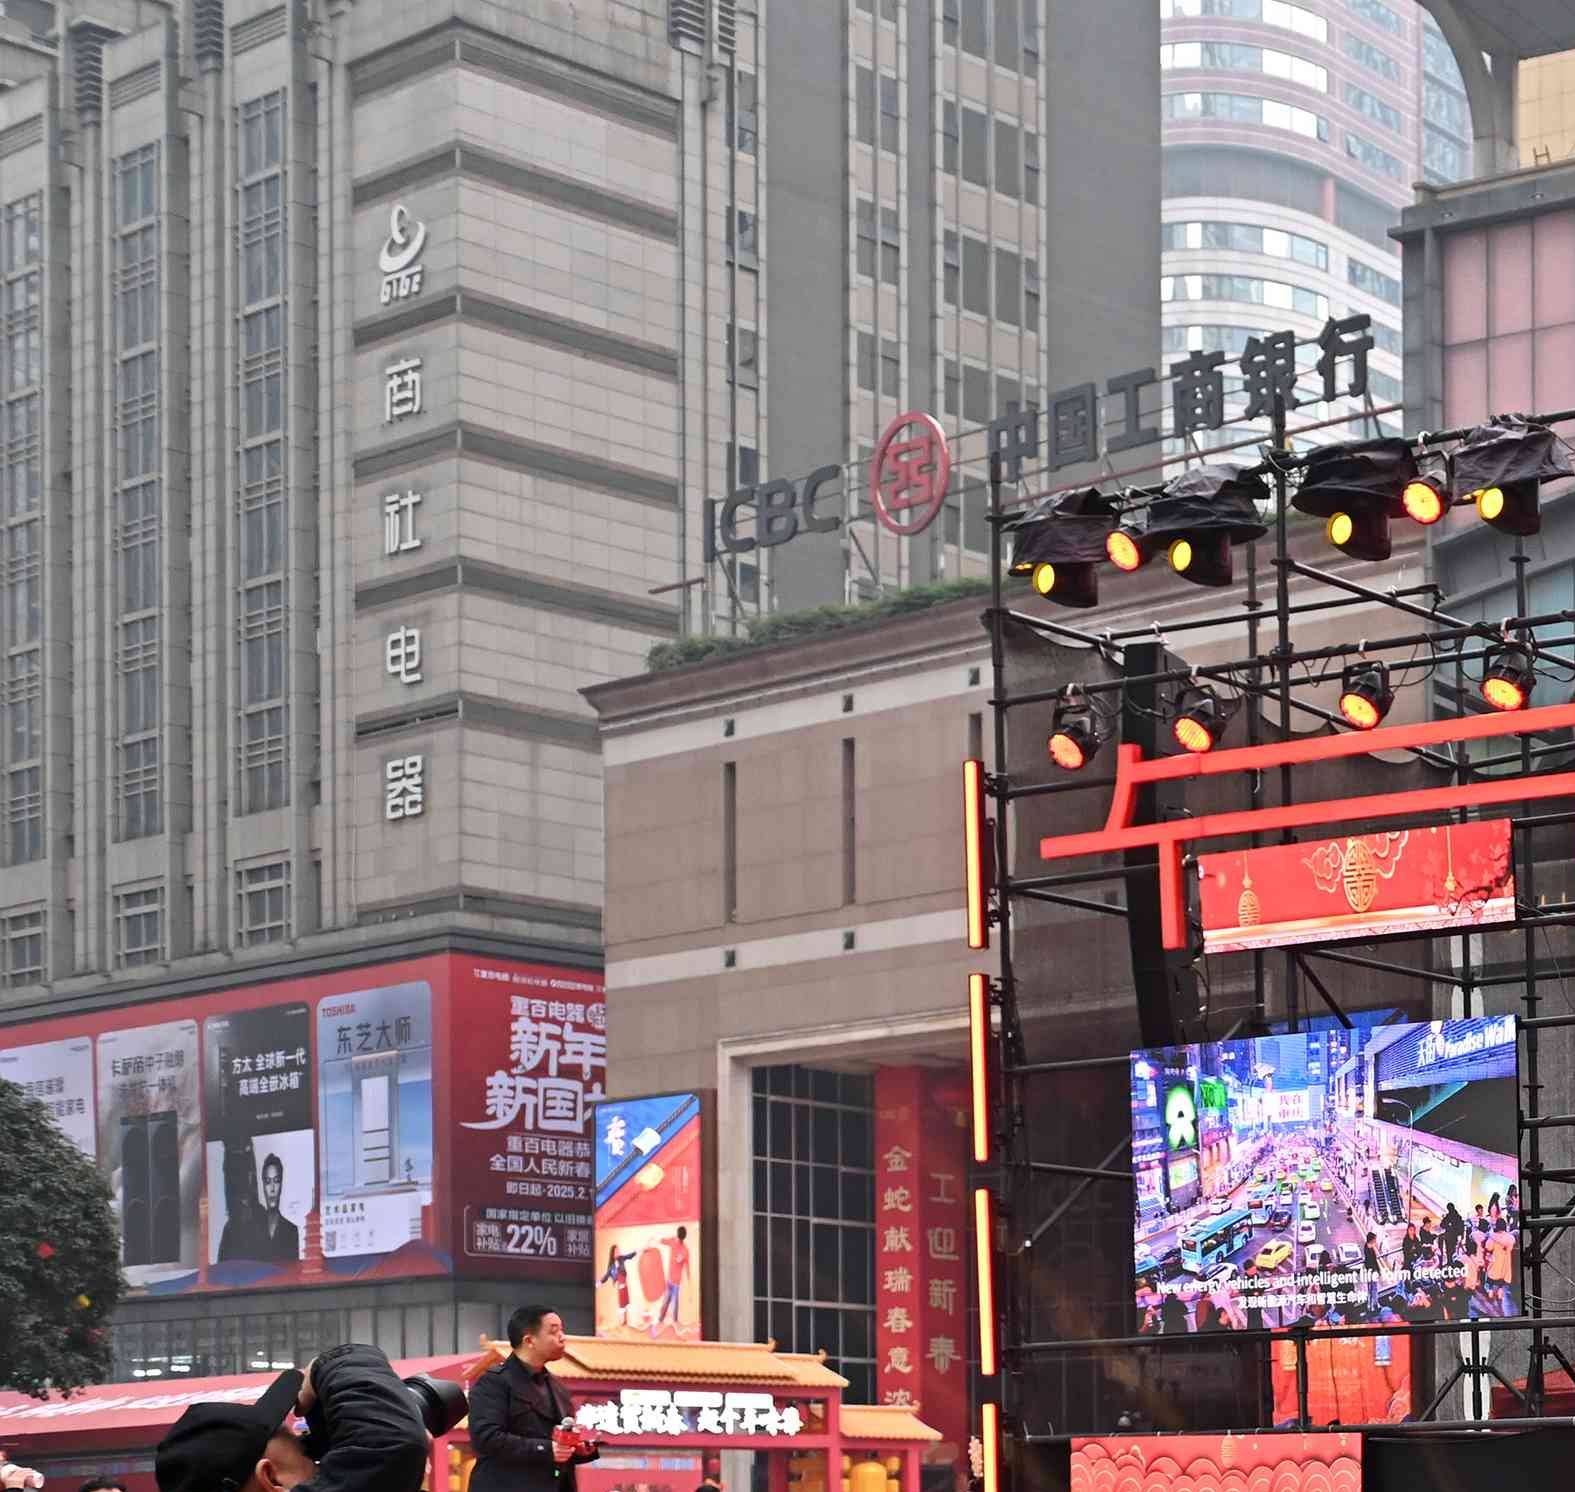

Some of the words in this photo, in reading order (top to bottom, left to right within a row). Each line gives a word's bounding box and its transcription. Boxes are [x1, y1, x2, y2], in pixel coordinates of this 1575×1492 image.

[987, 313, 1373, 482] 中国工商银行
[702, 463, 841, 563] ICBC
[385, 357, 424, 820] 商社电器
[510, 1016, 607, 1080] 新年
[506, 1224, 558, 1256] 22%
